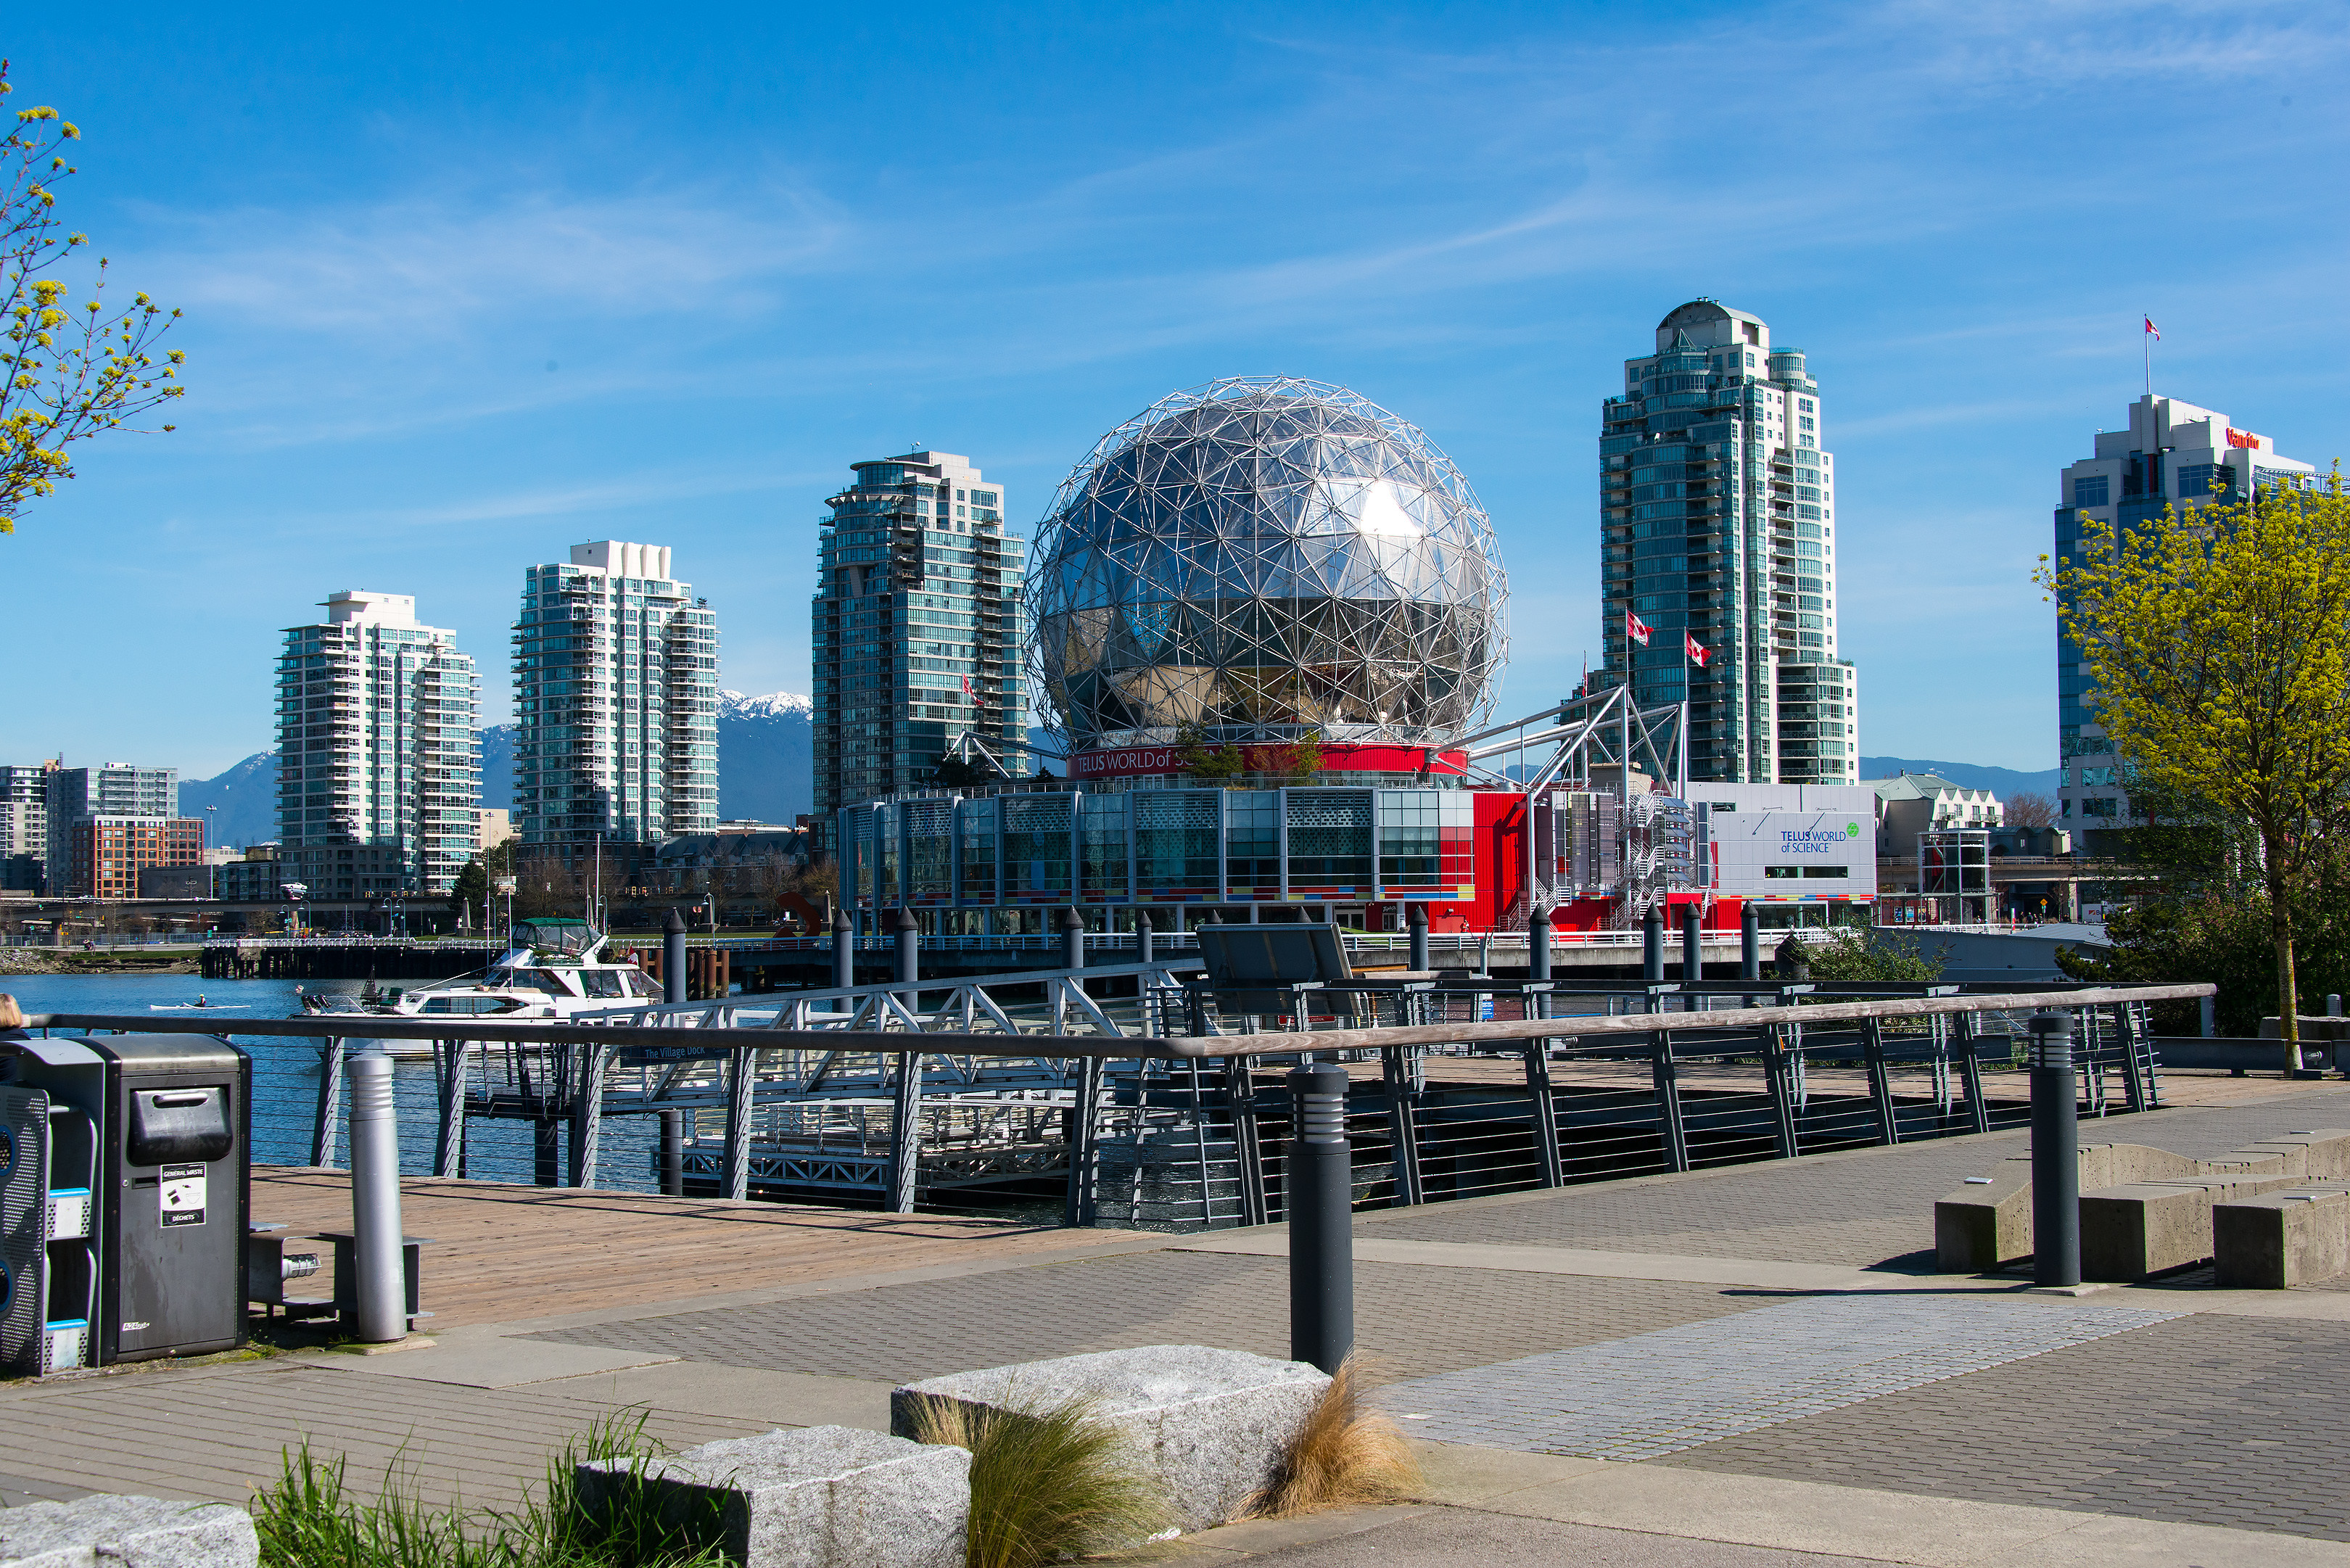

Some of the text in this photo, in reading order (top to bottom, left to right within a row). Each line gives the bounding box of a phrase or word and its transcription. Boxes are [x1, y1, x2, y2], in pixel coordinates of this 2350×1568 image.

[2226, 428, 2259, 450] Vancity
[1079, 756, 1105, 772] TELUS
[1106, 752, 1155, 769] WORLD
[1156, 750, 1171, 767] of
[1781, 831, 1846, 841] TELUS WORLD
[1781, 842, 1829, 852] of SCIENCE
[645, 1049, 659, 1059] The
[660, 1047, 685, 1058] Village
[687, 1047, 705, 1055] Dock
